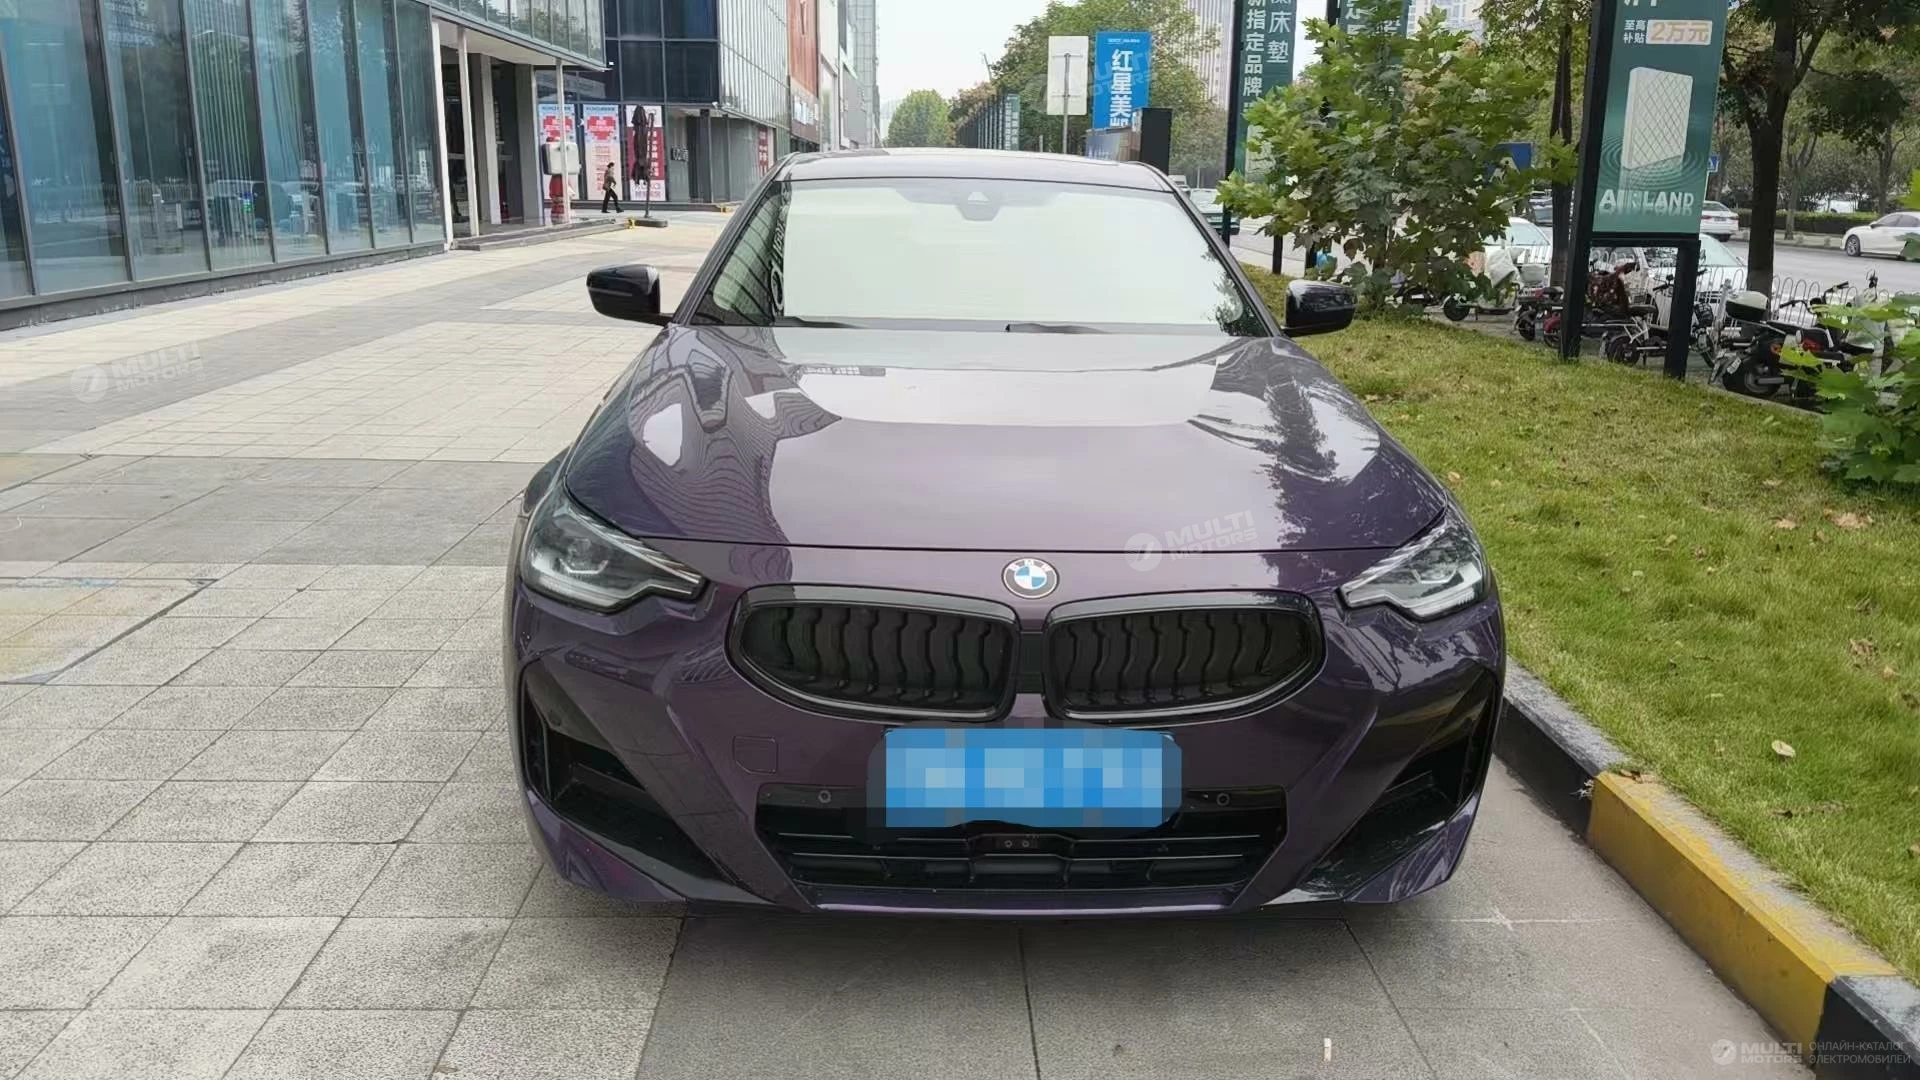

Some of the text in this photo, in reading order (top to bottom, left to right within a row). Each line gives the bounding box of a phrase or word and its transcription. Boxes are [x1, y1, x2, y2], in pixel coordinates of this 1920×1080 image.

[1266, 0, 1292, 63] 床墊
[1624, 19, 1646, 31] 至高
[1651, 22, 1709, 43] 2万元
[1623, 33, 1646, 44] 补贴
[1242, 0, 1267, 112] 指定品牌
[1598, 188, 1695, 209] AIRLAND
